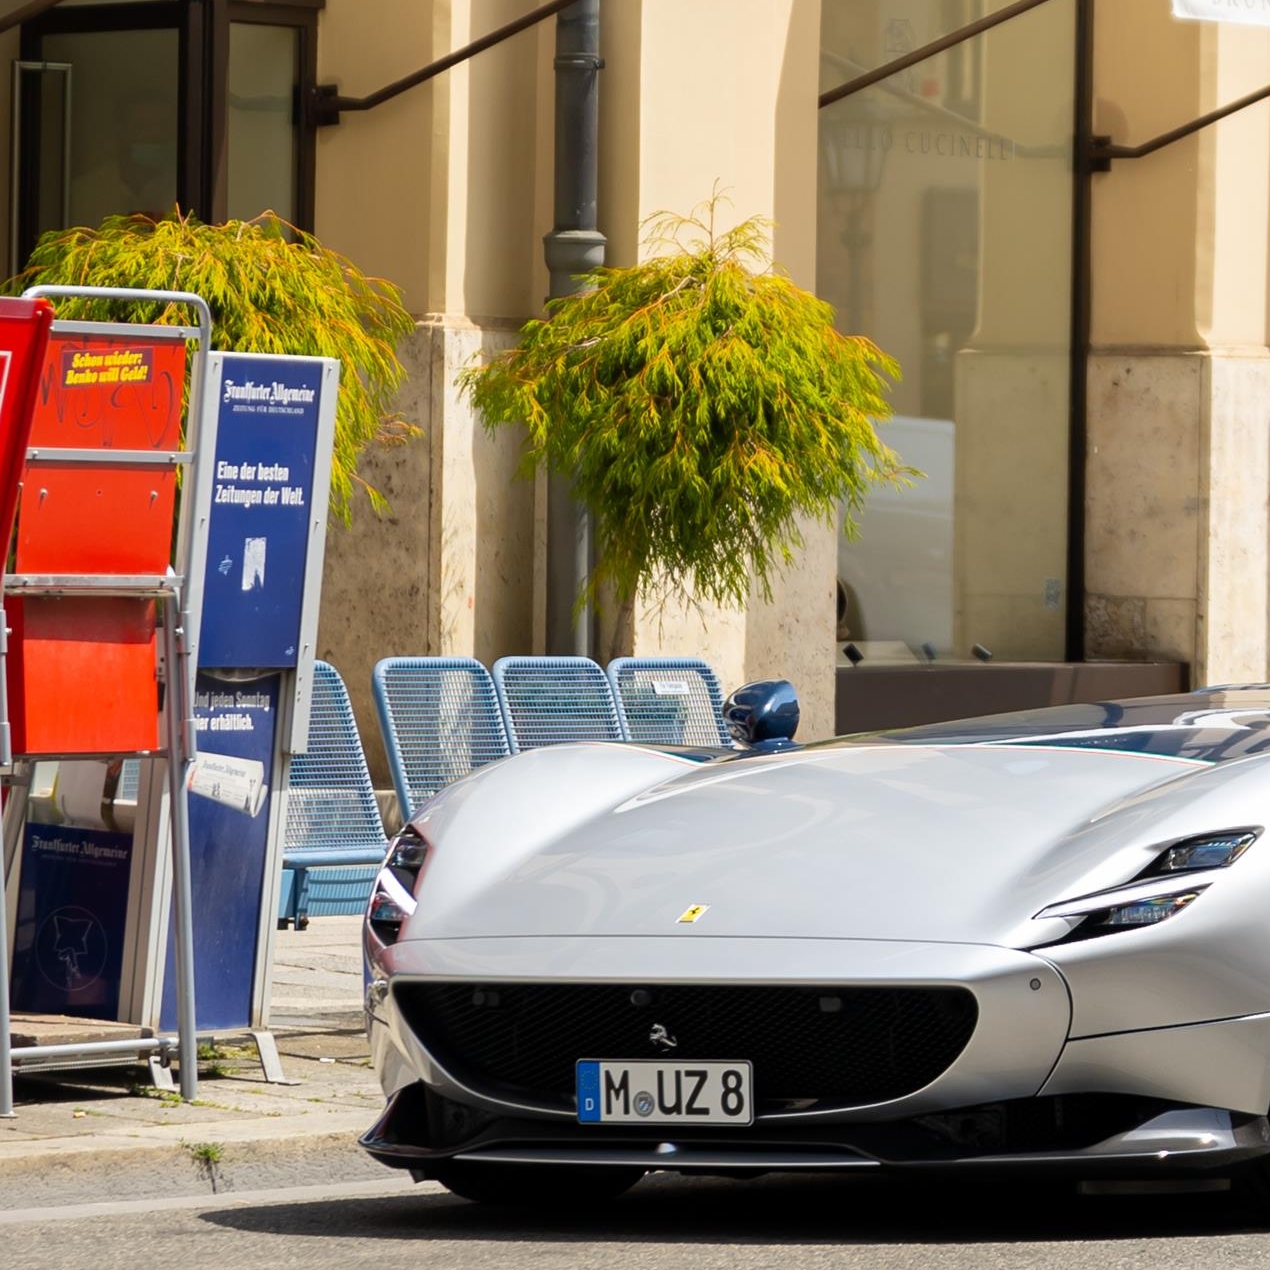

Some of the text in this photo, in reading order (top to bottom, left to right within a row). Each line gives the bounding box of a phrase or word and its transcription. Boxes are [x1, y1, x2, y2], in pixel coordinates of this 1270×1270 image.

[99, 367, 120, 382] will
[120, 365, 149, 381] Geld!
[224, 379, 315, 405] Frankfurter Allgemeine
[217, 461, 289, 481] Eine der besten
[215, 485, 305, 508] Zeitungen der Welt.
[210, 692, 235, 712] jeden
[236, 691, 270, 712] Sonntag
[194, 714, 254, 730] ier erhältlich.
[604, 1070, 744, 1116] M UZ 8
[585, 1098, 594, 1111] D
